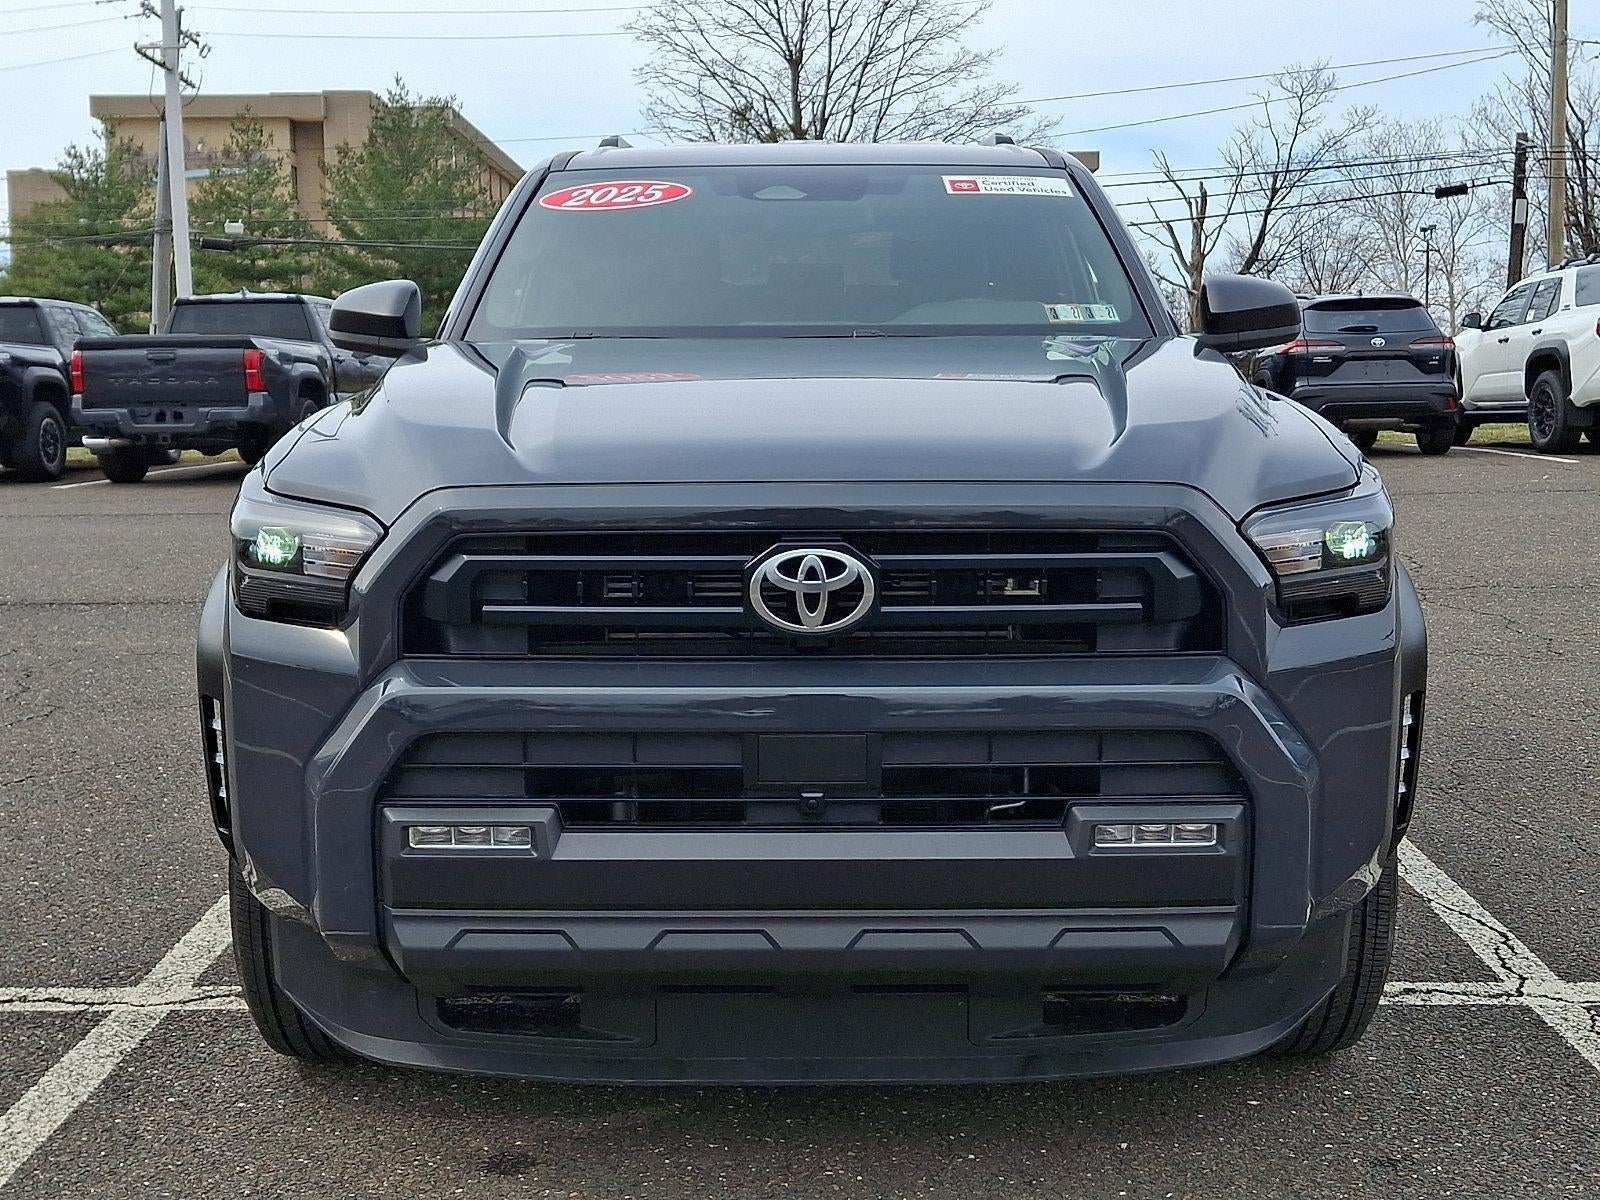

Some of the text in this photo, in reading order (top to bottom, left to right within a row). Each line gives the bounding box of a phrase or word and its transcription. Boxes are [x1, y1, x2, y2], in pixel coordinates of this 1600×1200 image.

[561, 184, 669, 206] 2025
[1017, 186, 1067, 195] Vehicles
[108, 376, 220, 385] TACOMA
